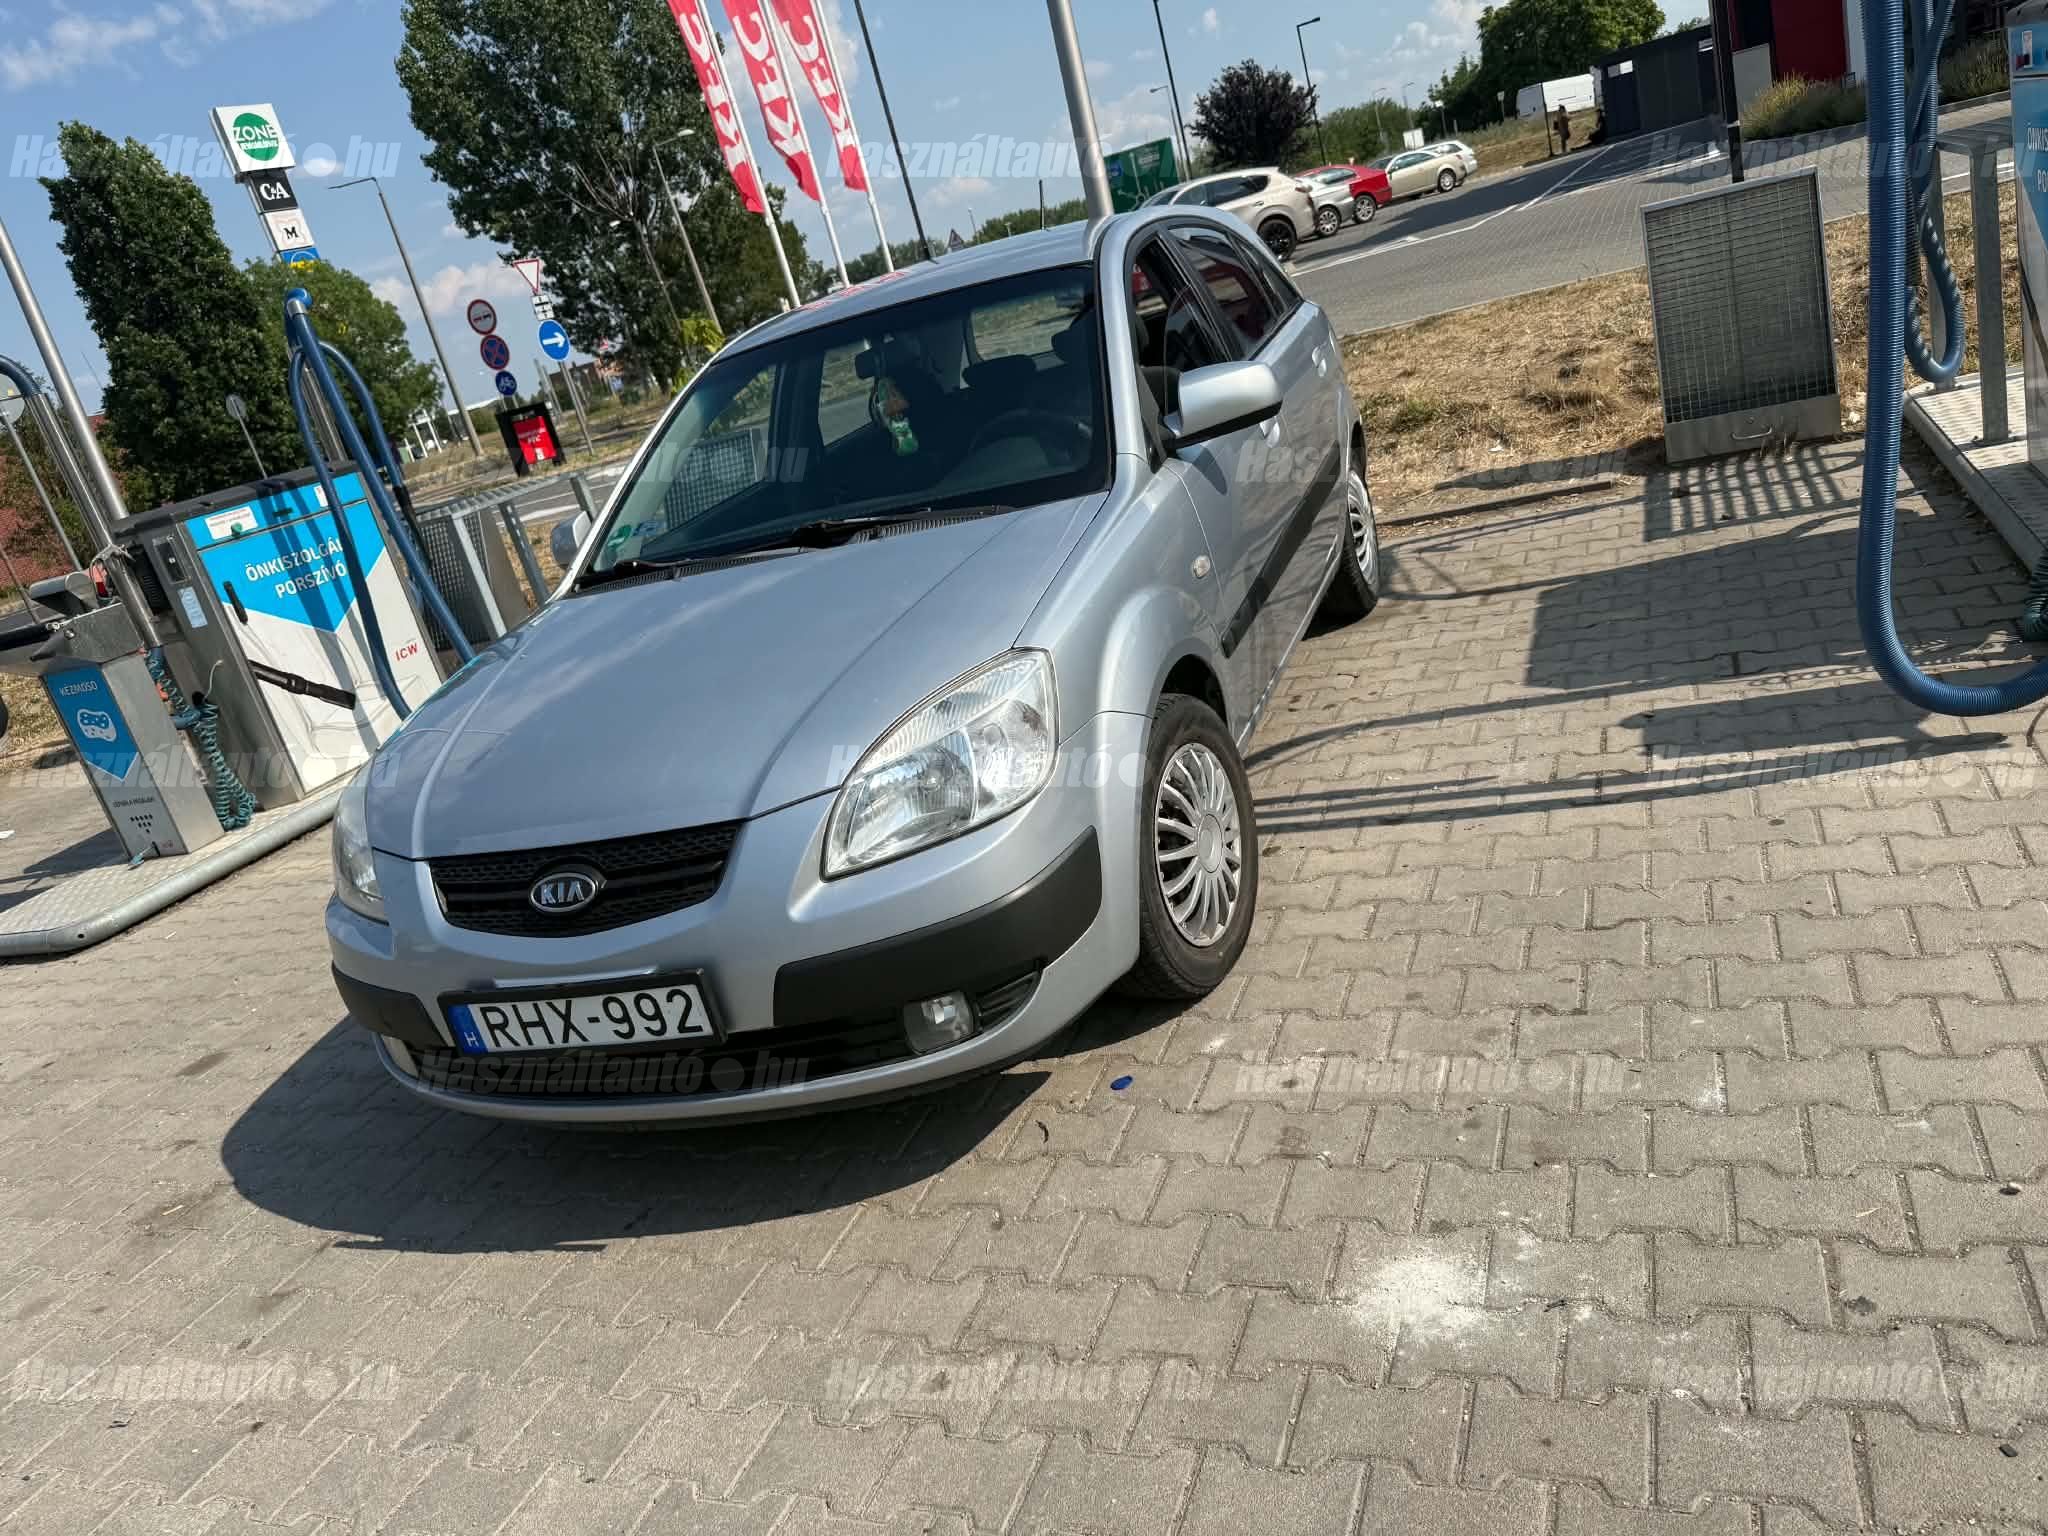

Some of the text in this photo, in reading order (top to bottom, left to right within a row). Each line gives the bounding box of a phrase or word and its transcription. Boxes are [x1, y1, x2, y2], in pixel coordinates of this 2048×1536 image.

[679, 12, 747, 171] KFC
[733, 11, 807, 157] KFC
[783, 15, 856, 152] KFC
[232, 124, 278, 142] ZONE
[259, 181, 291, 201] C&A
[283, 225, 299, 240] M
[275, 559, 347, 599] PORSZÍVÓ
[395, 642, 418, 661] ICW
[540, 879, 585, 905] KIA
[463, 987, 704, 1049] H RHX-992
